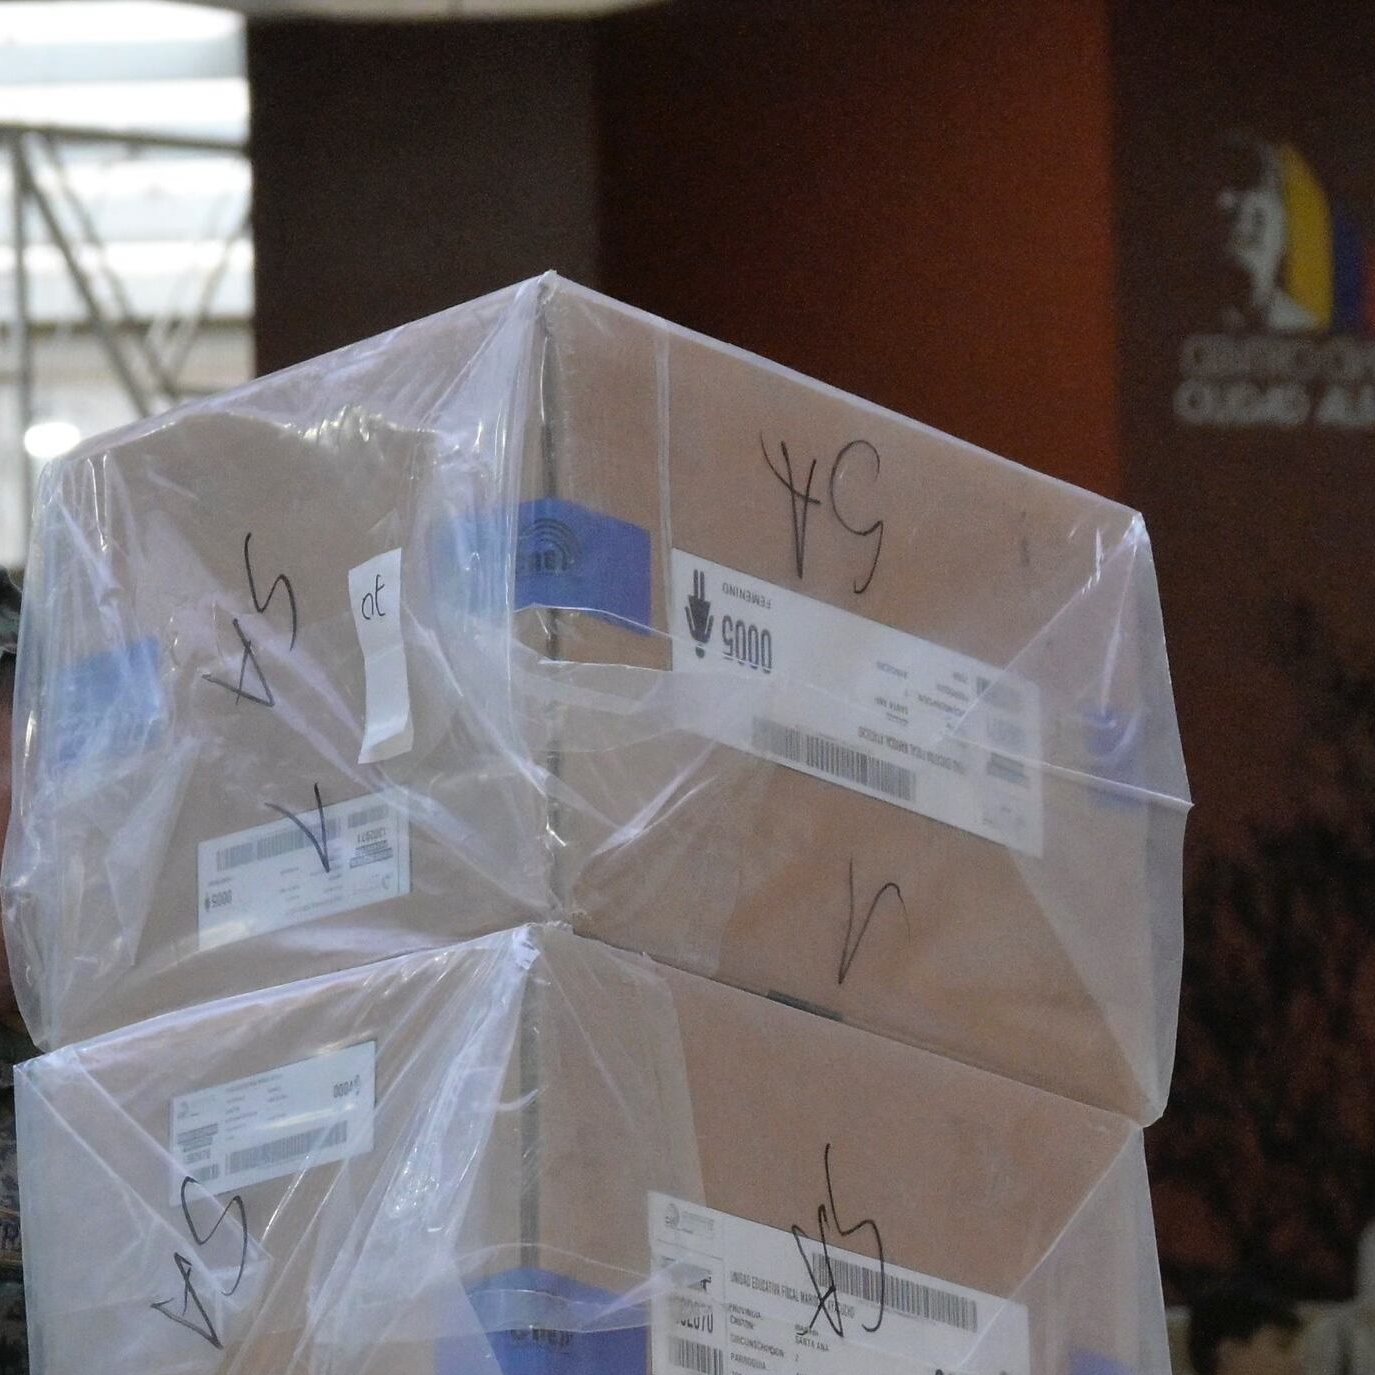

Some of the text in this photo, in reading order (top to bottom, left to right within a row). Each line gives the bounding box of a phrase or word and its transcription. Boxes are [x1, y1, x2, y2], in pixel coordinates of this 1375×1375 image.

[722, 583, 772, 608] FEMENINO
[720, 615, 774, 676] 0005
[795, 1336, 829, 1352] SANTA ANA
